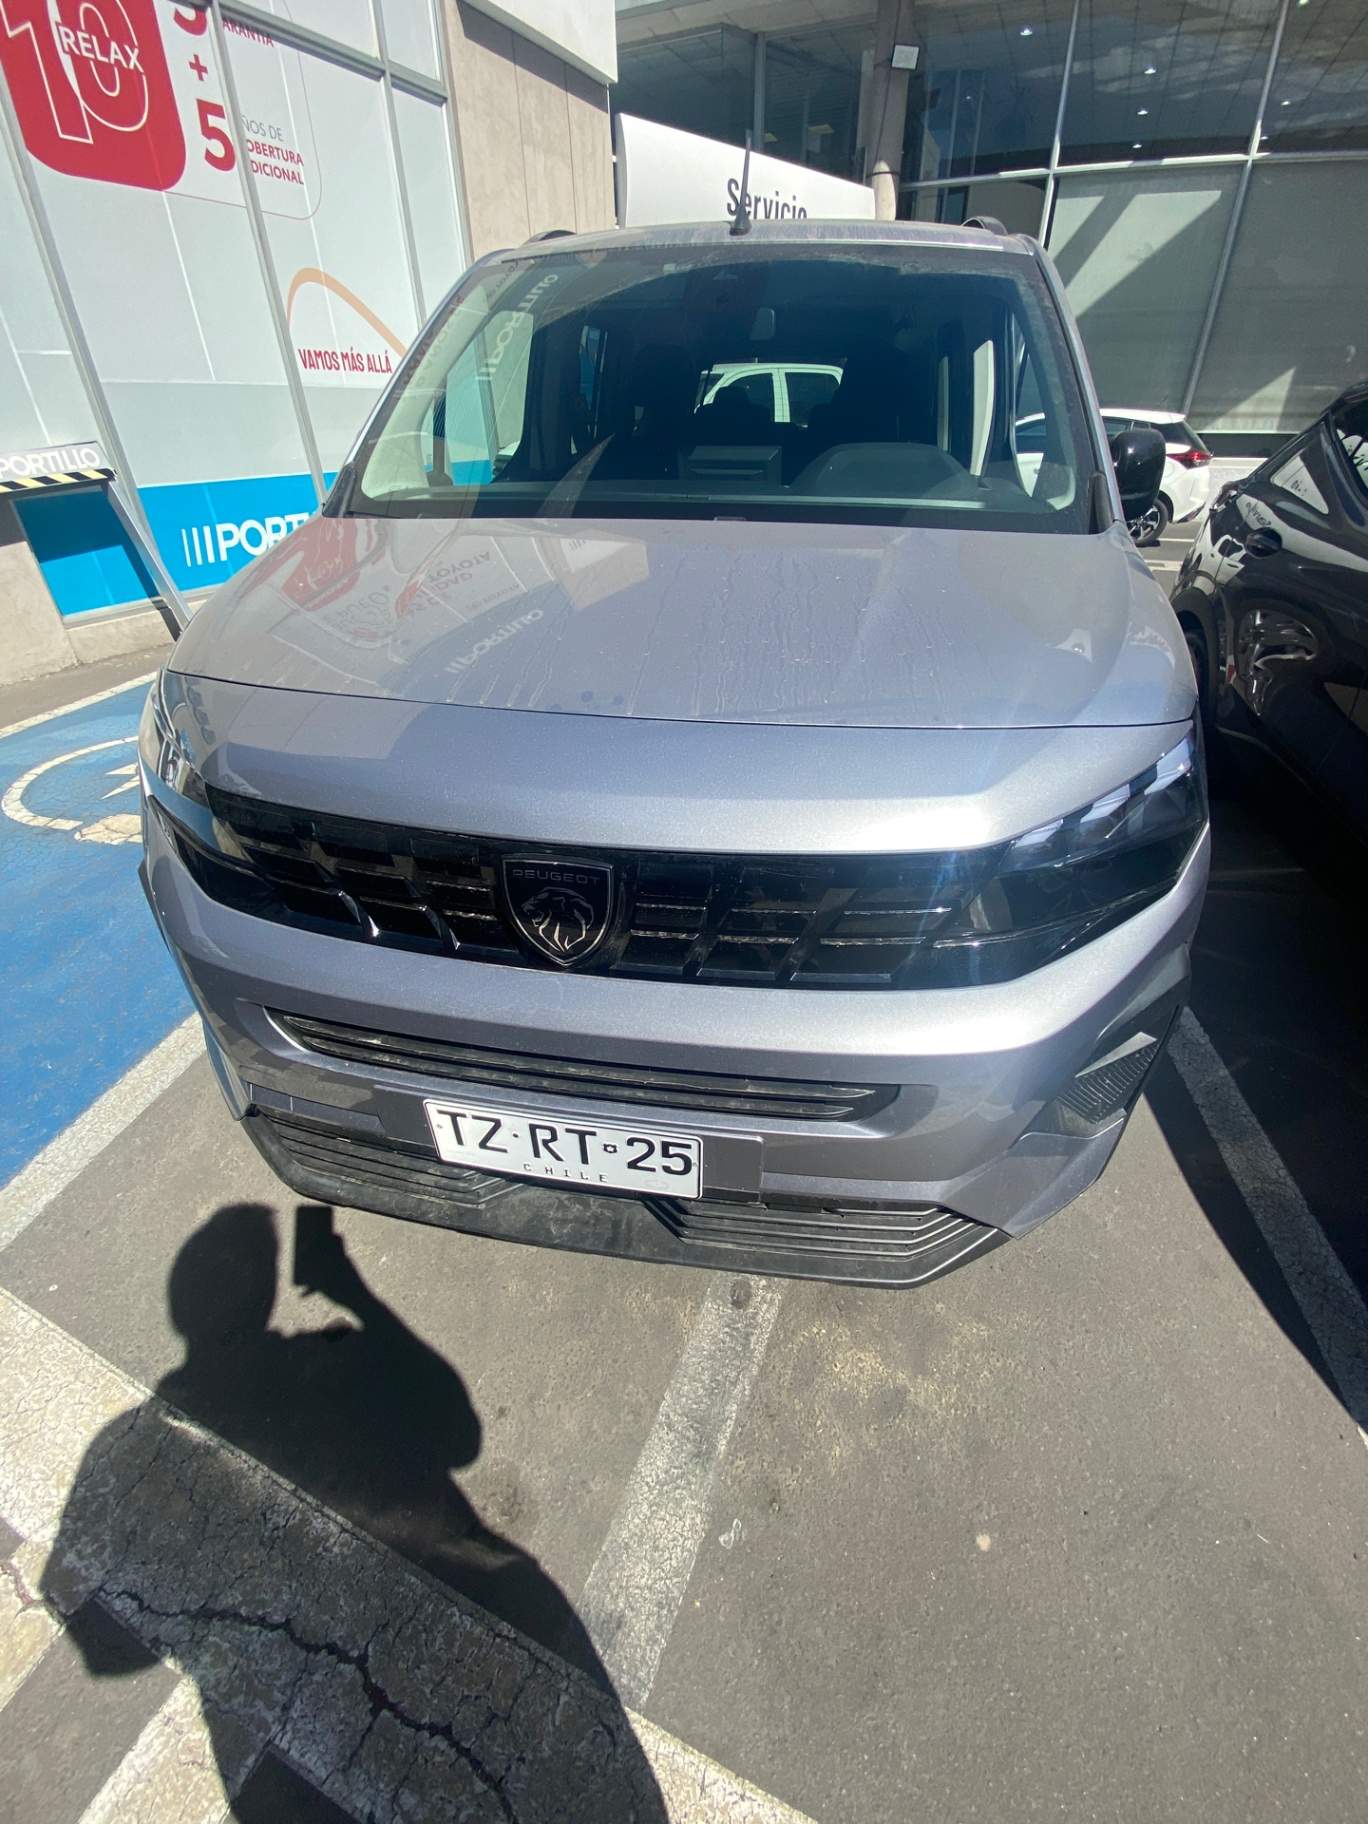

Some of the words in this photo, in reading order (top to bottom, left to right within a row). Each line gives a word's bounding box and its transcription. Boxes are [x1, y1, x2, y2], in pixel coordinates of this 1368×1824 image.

[57, 24, 145, 74] RELAX
[196, 98, 236, 172] 5
[241, 114, 267, 138] ÑOS
[268, 124, 284, 142] DE
[246, 139, 304, 167] OBERTURA
[250, 160, 304, 185] DICIONAL
[298, 348, 341, 371] VAMOS
[341, 346, 365, 373] MÁS
[366, 350, 393, 374] ALLÁ
[0, 447, 100, 480] PORTILLO
[214, 511, 310, 562] PORT
[511, 869, 601, 887] PEUGEOT
[522, 1162, 609, 1183] CHILE
